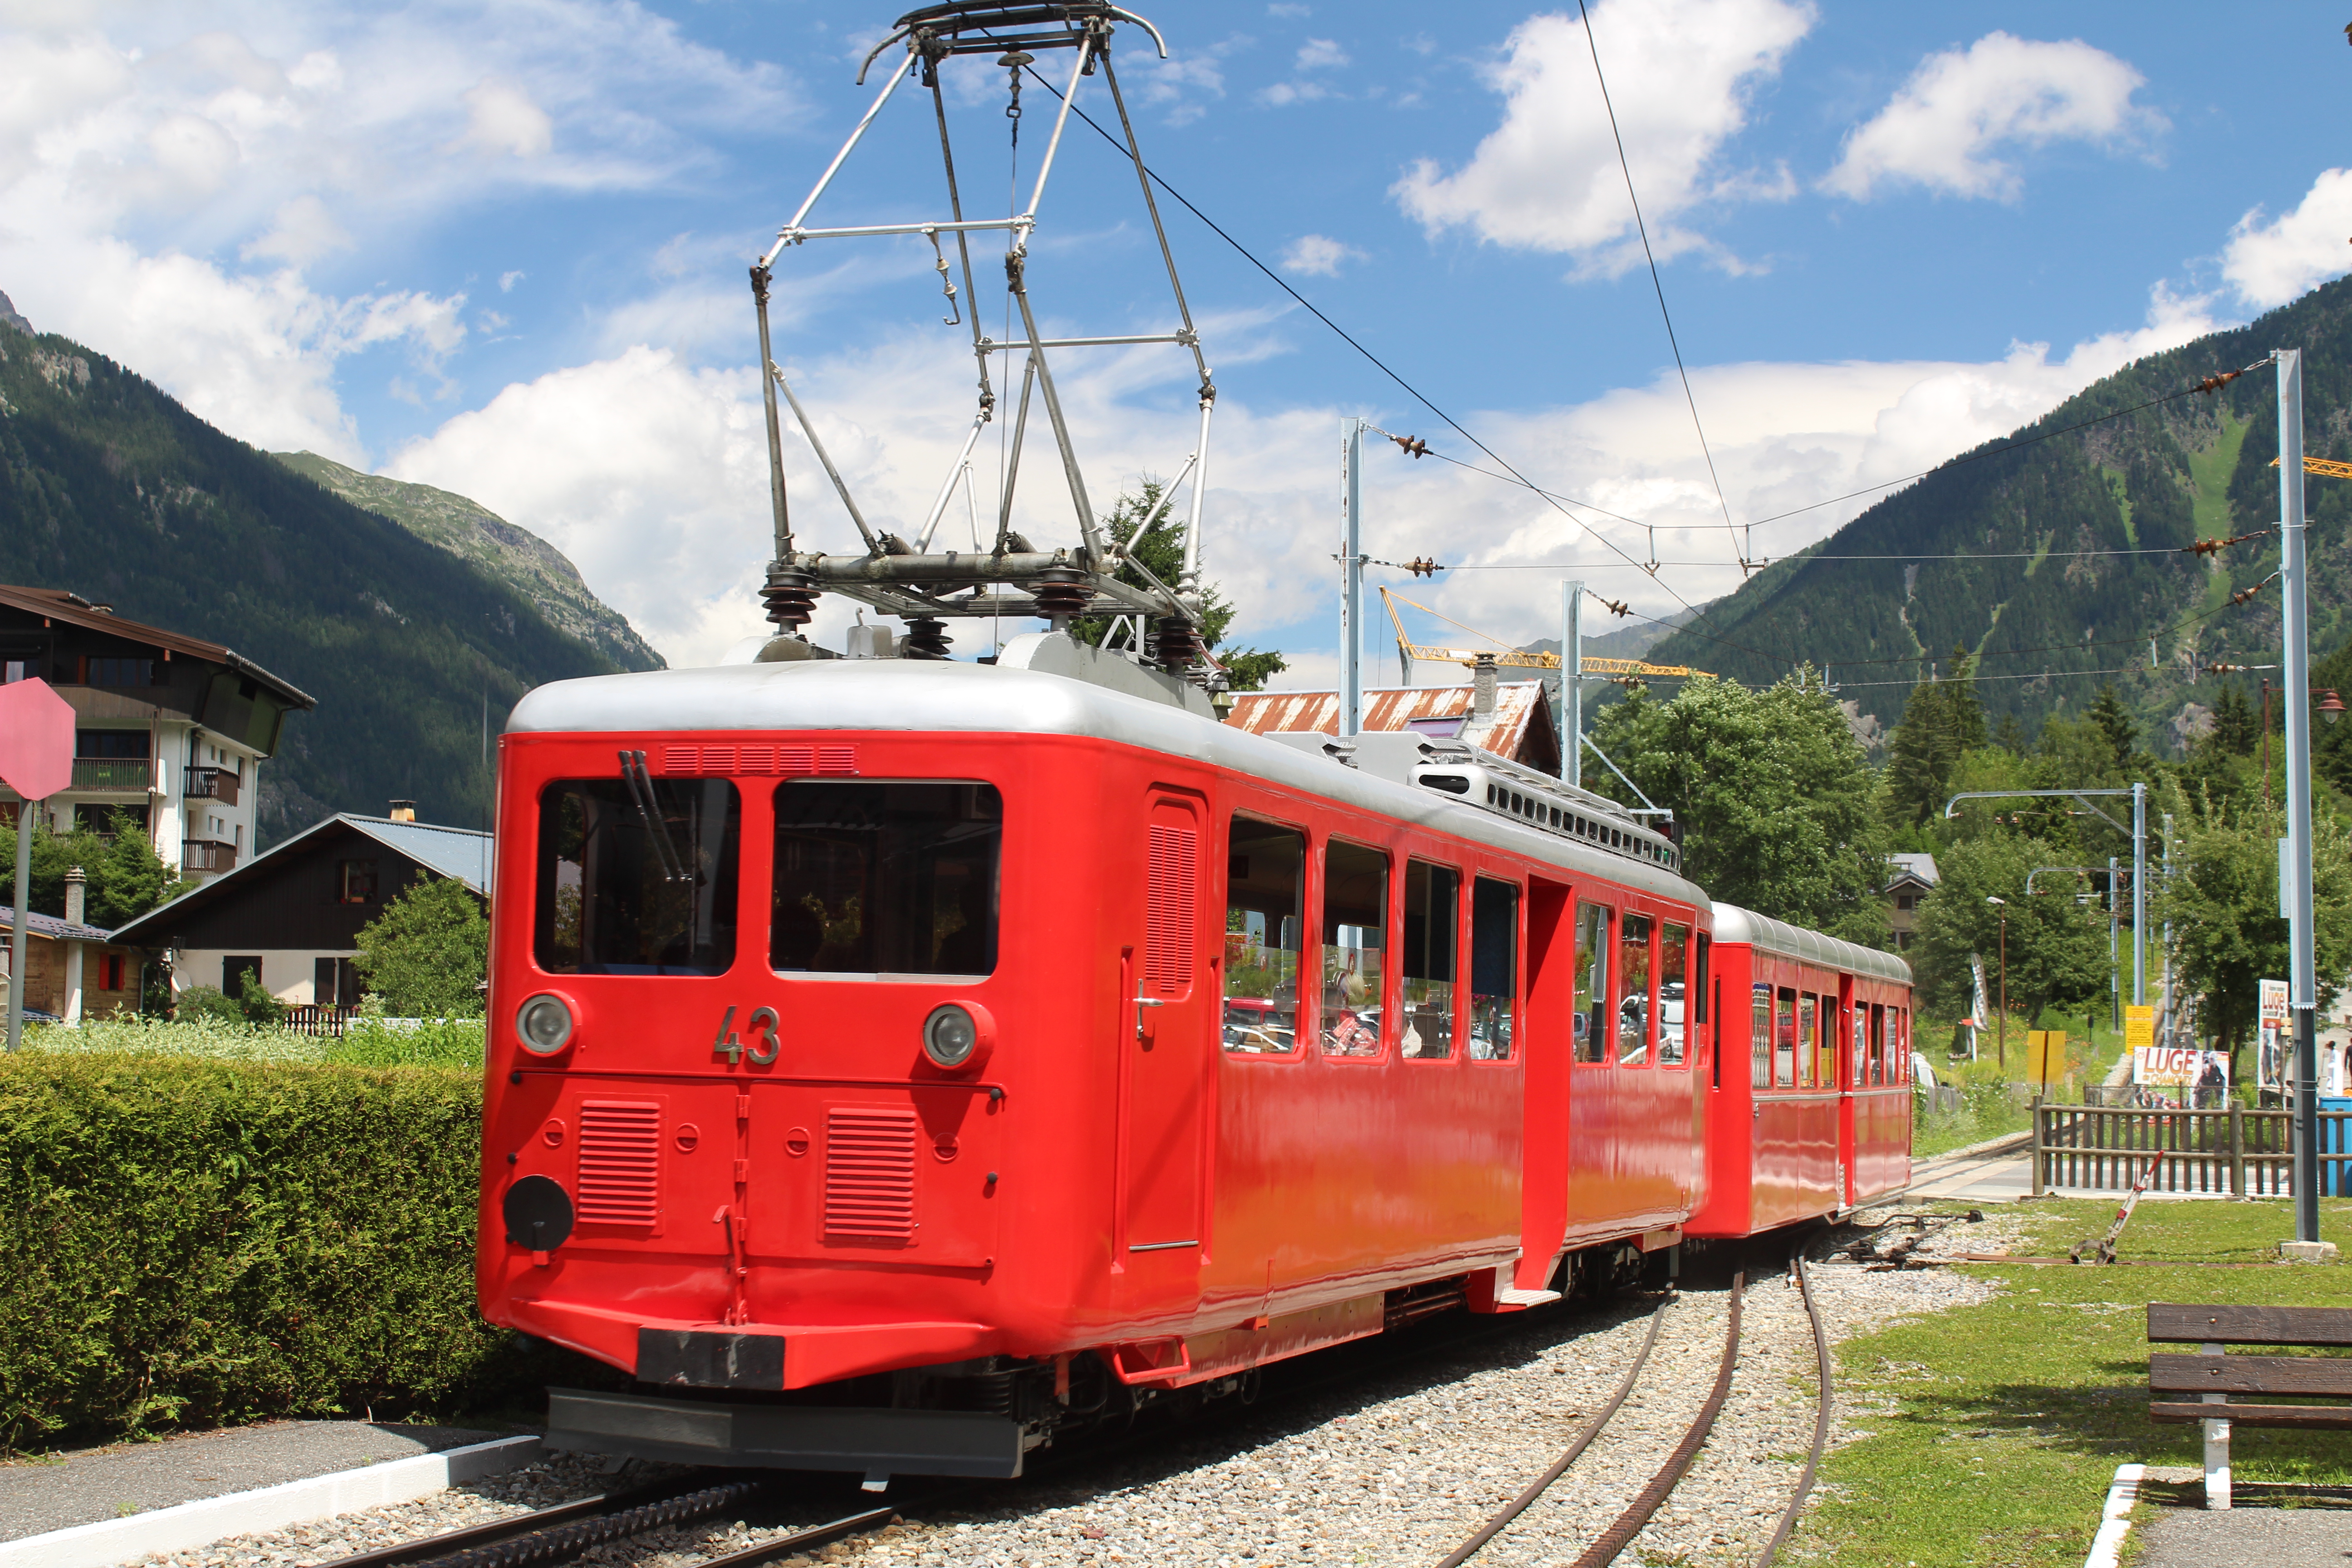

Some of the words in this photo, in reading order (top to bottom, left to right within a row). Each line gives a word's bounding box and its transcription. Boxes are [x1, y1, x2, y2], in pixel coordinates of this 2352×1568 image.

[2262, 984, 2284, 1016] Luge
[714, 1005, 781, 1064] 43
[2144, 1048, 2197, 1075] LUGE
